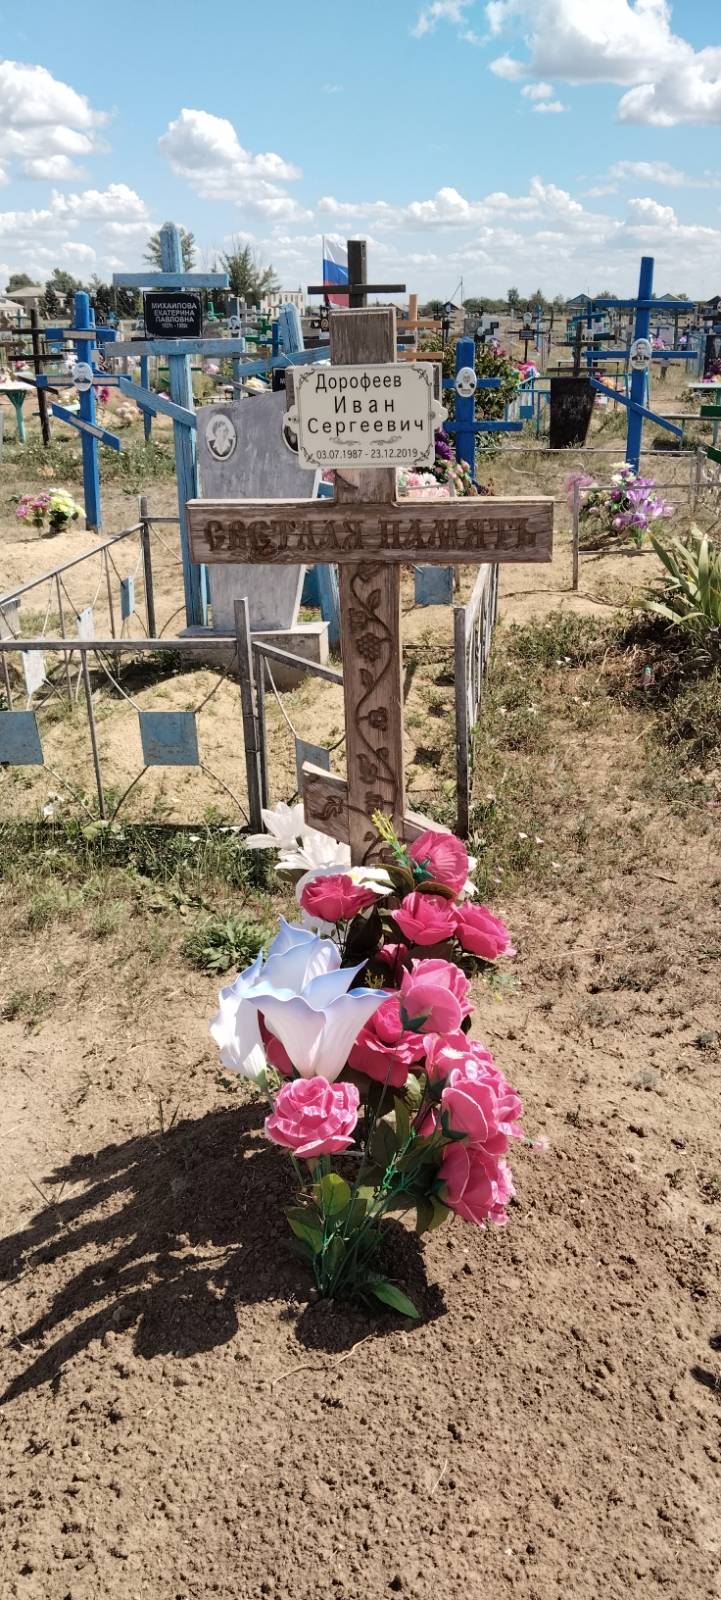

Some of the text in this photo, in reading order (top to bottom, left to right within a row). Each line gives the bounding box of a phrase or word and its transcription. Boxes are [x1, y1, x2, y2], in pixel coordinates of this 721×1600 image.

[315, 372, 402, 393] Дорофеев
[334, 395, 395, 414] Иван
[307, 417, 424, 436] Сергеевич
[316, 450, 362, 460] 03.07.1987
[371, 449, 418, 458] 23.12.2019
[379, 518, 537, 550] ПАМЯТЬ
